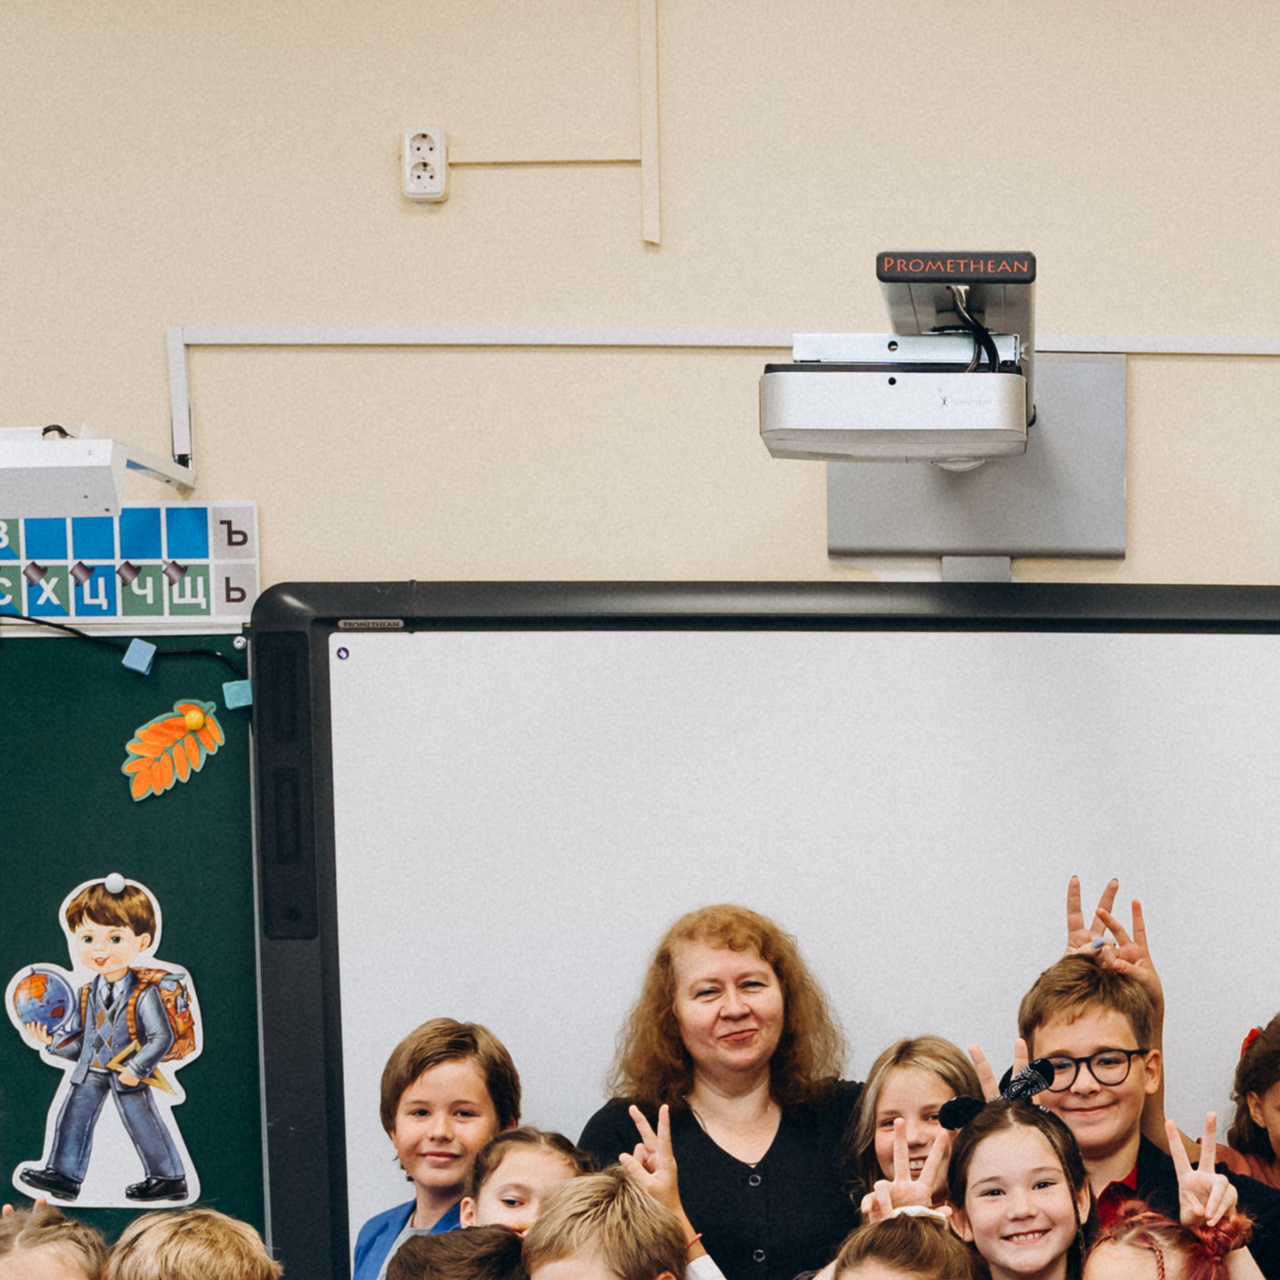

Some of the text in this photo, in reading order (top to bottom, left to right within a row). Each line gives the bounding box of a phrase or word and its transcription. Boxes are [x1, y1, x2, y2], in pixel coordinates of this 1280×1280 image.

[884, 257, 1028, 274] PROMETHEAN
[219, 520, 248, 546] Ъ
[37, 577, 60, 605] Х
[83, 577, 108, 610] Ц
[131, 577, 153, 604] Ч
[172, 576, 207, 609] Щ
[225, 577, 247, 603] Ь
